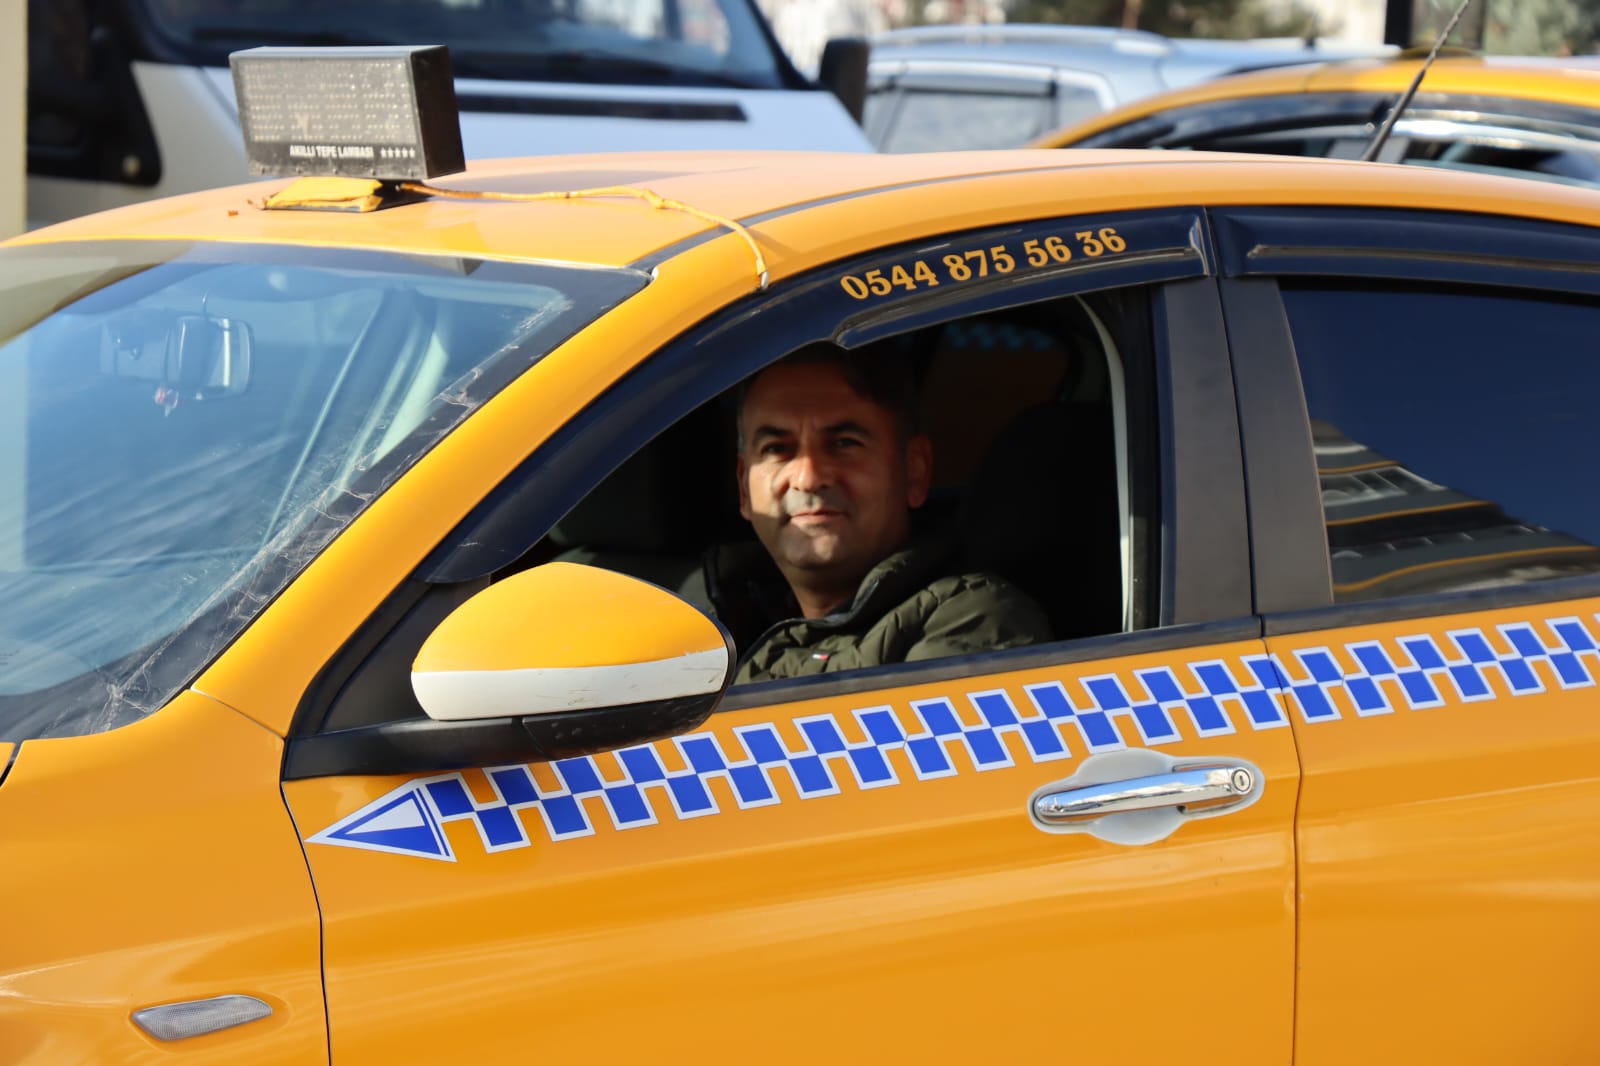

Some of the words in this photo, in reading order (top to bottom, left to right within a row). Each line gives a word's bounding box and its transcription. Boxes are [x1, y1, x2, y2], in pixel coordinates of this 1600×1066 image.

[289, 145, 315, 158] AKILLI
[316, 145, 337, 158] TEPE
[338, 146, 374, 159] LAMBASI
[840, 261, 939, 300] 0544
[943, 245, 1015, 281] 875
[1024, 236, 1072, 268] 56
[1075, 228, 1127, 257] 36
